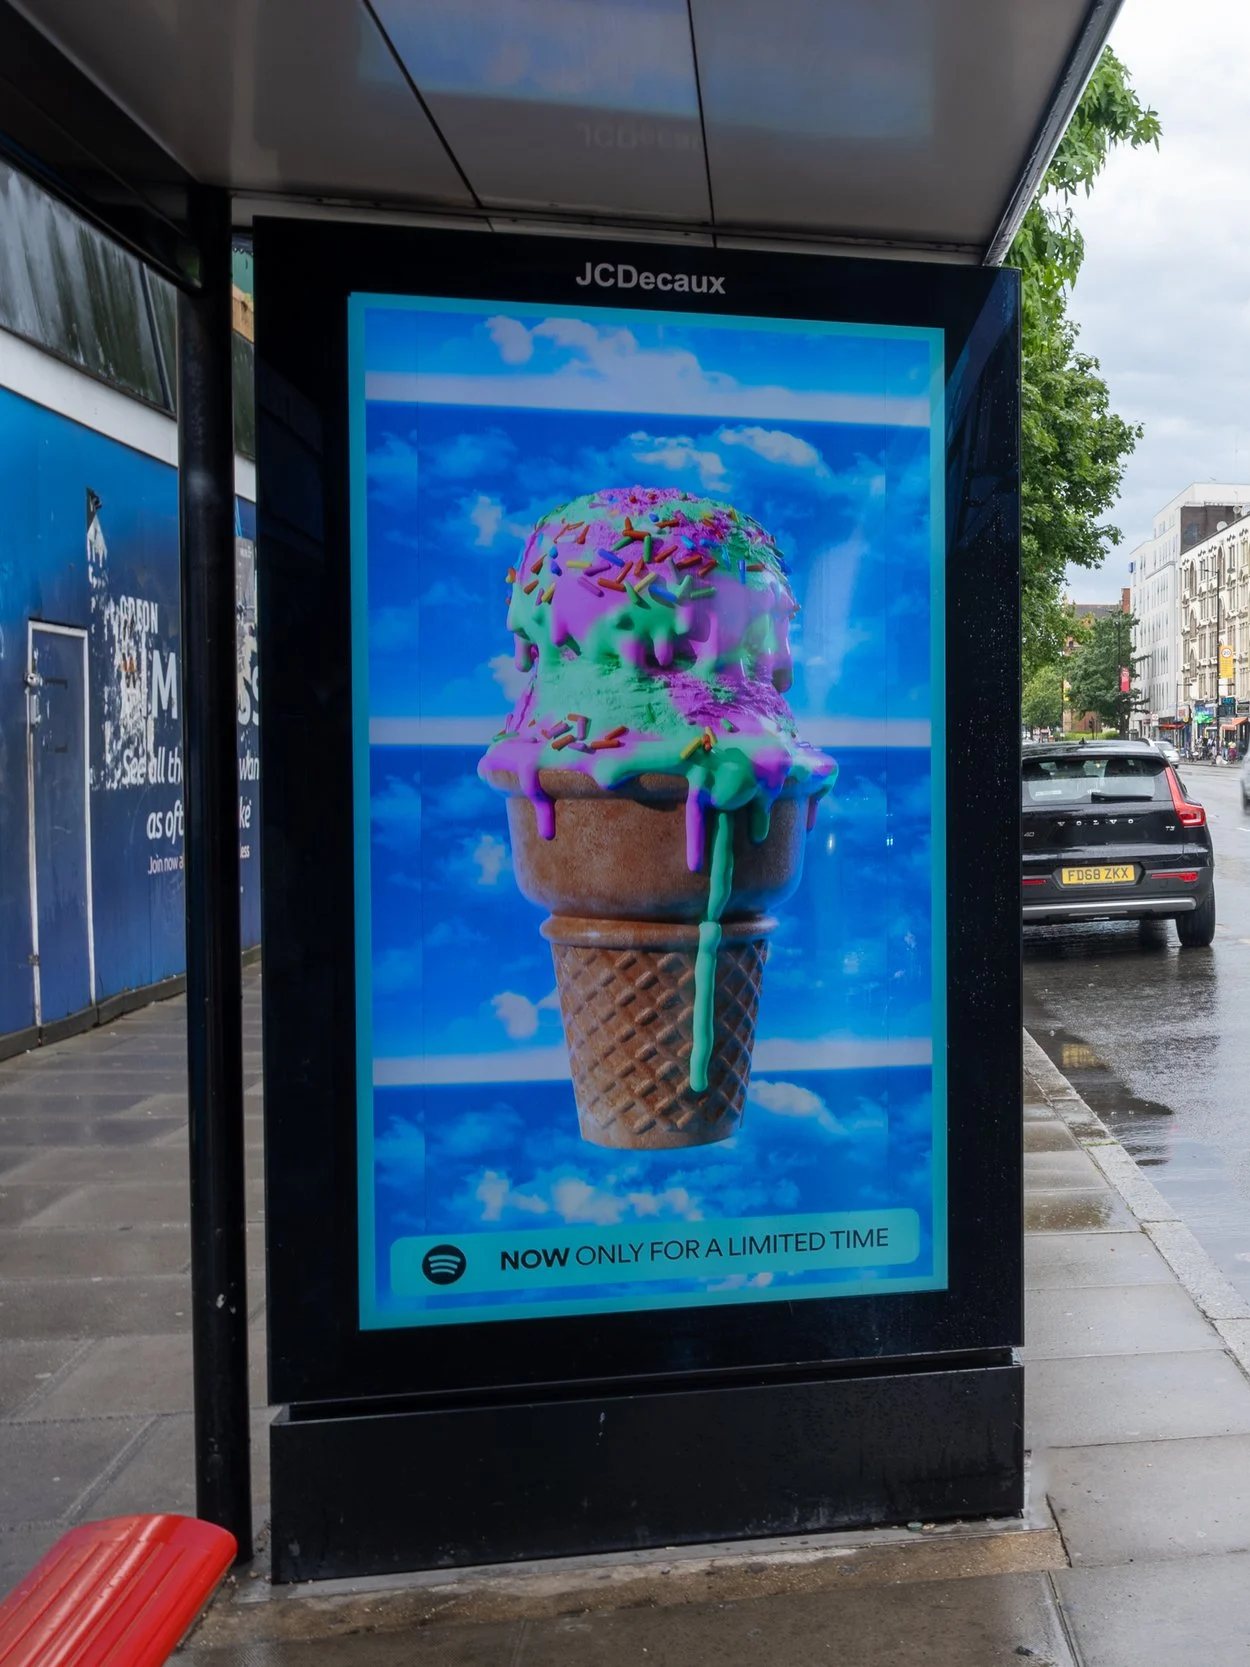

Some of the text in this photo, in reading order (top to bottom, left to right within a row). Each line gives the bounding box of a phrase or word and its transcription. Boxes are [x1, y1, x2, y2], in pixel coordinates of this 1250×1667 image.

[575, 262, 726, 294] JCDecaux
[146, 810, 163, 840] as
[165, 799, 184, 845] oft
[1057, 818, 1134, 827] VOLVO
[147, 854, 163, 875] Join
[164, 857, 178, 871] now
[1068, 867, 1129, 882] FD68 ZKX
[500, 1228, 889, 1271] NOW ONLY FOR A LIMITED TIME
